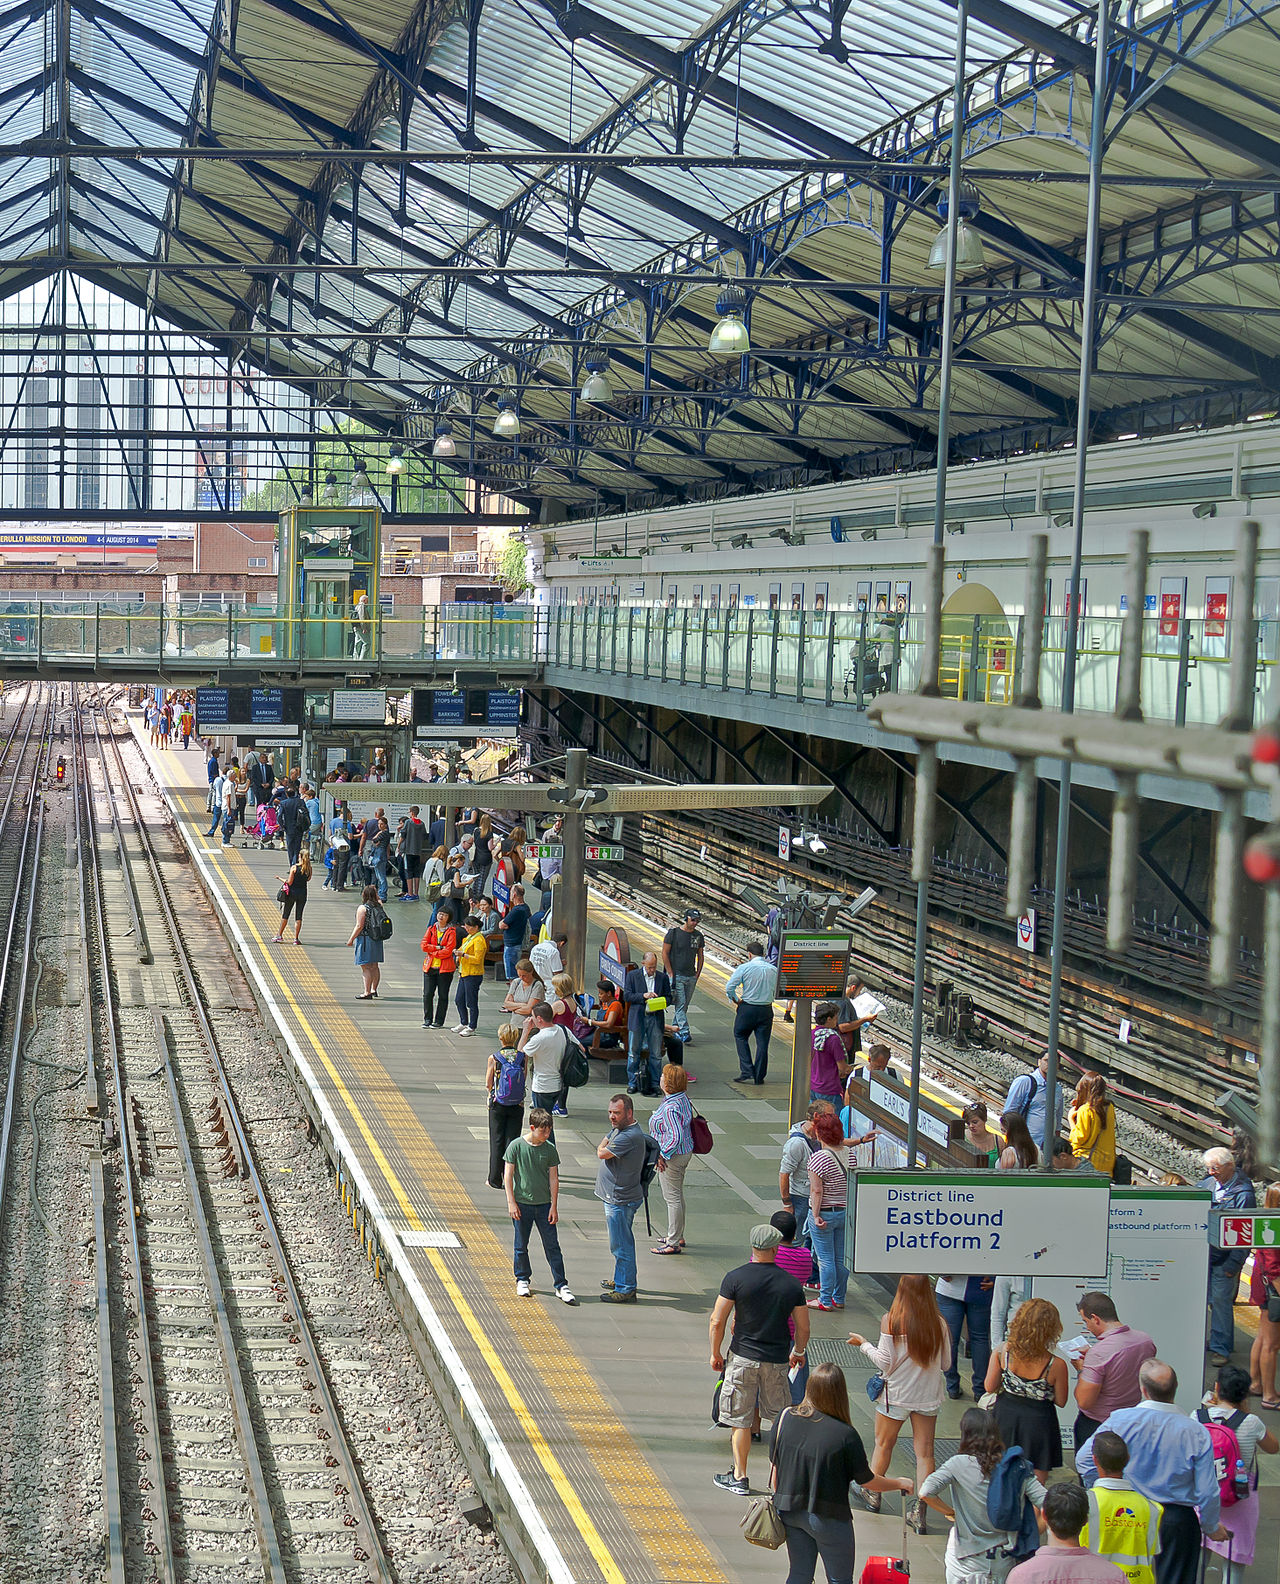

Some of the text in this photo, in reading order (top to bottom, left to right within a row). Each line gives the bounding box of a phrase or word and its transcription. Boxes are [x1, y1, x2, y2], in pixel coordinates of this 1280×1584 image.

[888, 1190, 974, 1202] District line
[887, 1208, 1003, 1226] Eastbound
[1153, 1223, 1190, 1231] platform
[886, 1231, 1000, 1251] platform 2
